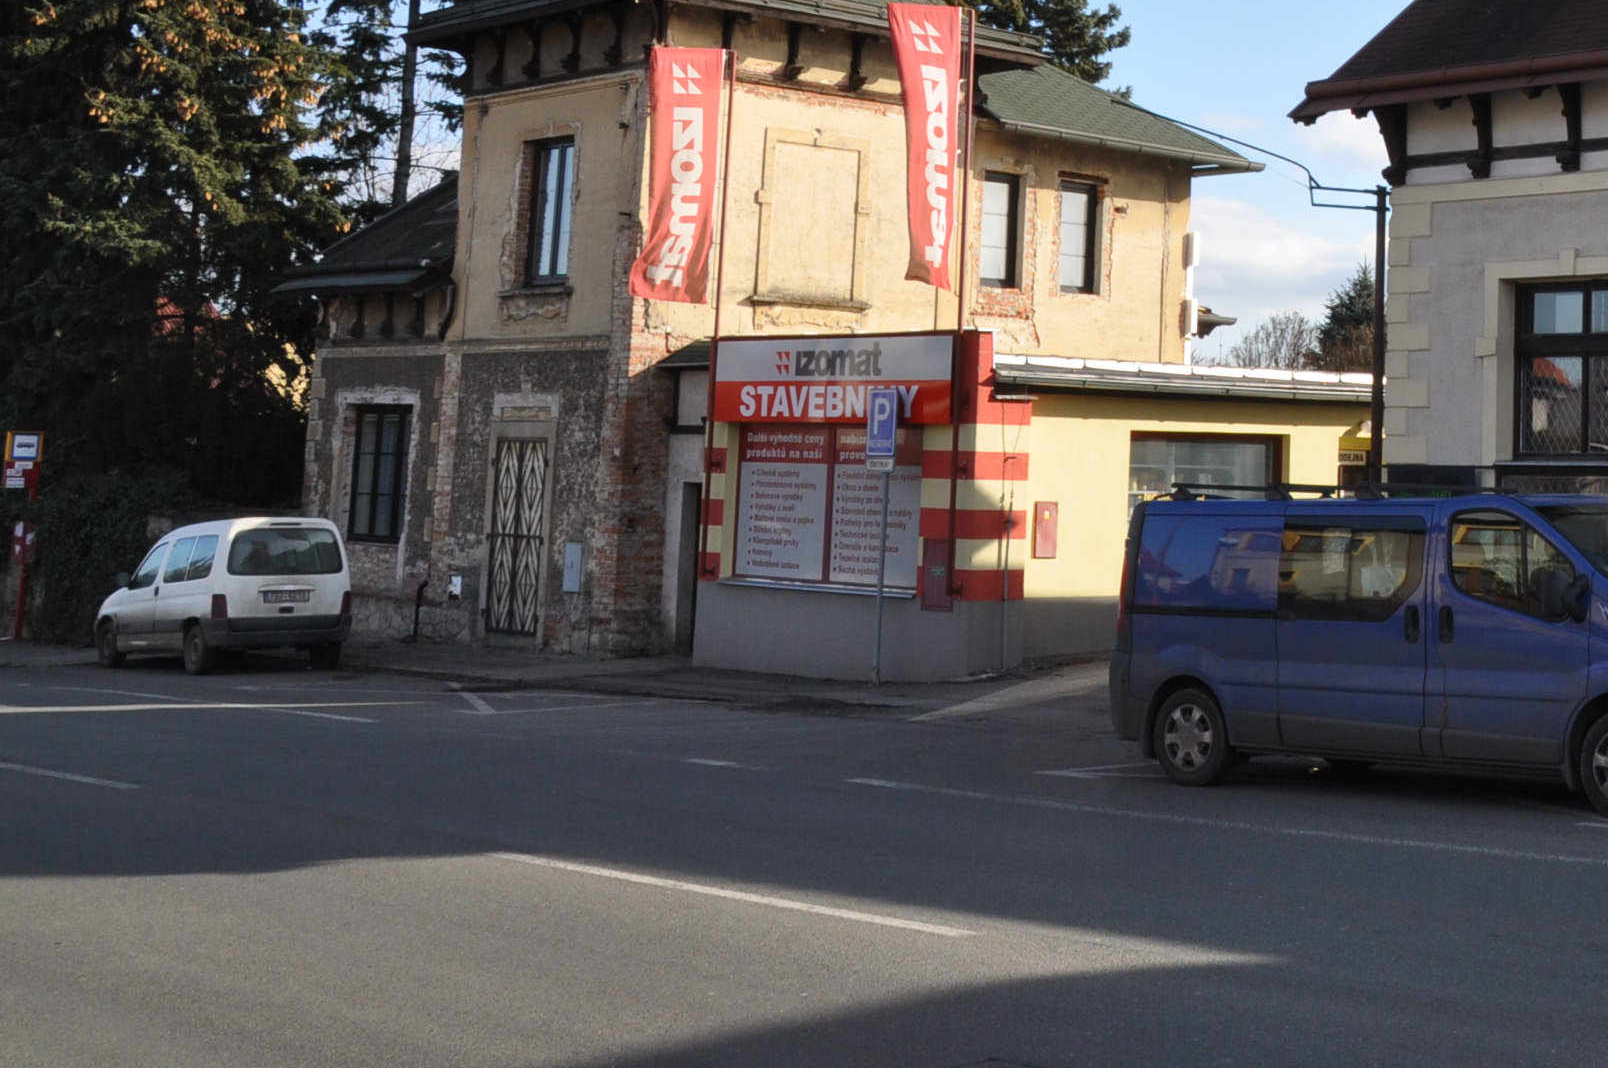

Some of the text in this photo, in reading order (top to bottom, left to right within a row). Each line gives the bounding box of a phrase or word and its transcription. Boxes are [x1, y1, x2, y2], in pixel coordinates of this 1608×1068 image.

[739, 385, 920, 419] STAVEBNY
[873, 398, 891, 435] P
[804, 435, 825, 446] ceny
[789, 451, 800, 459] na
